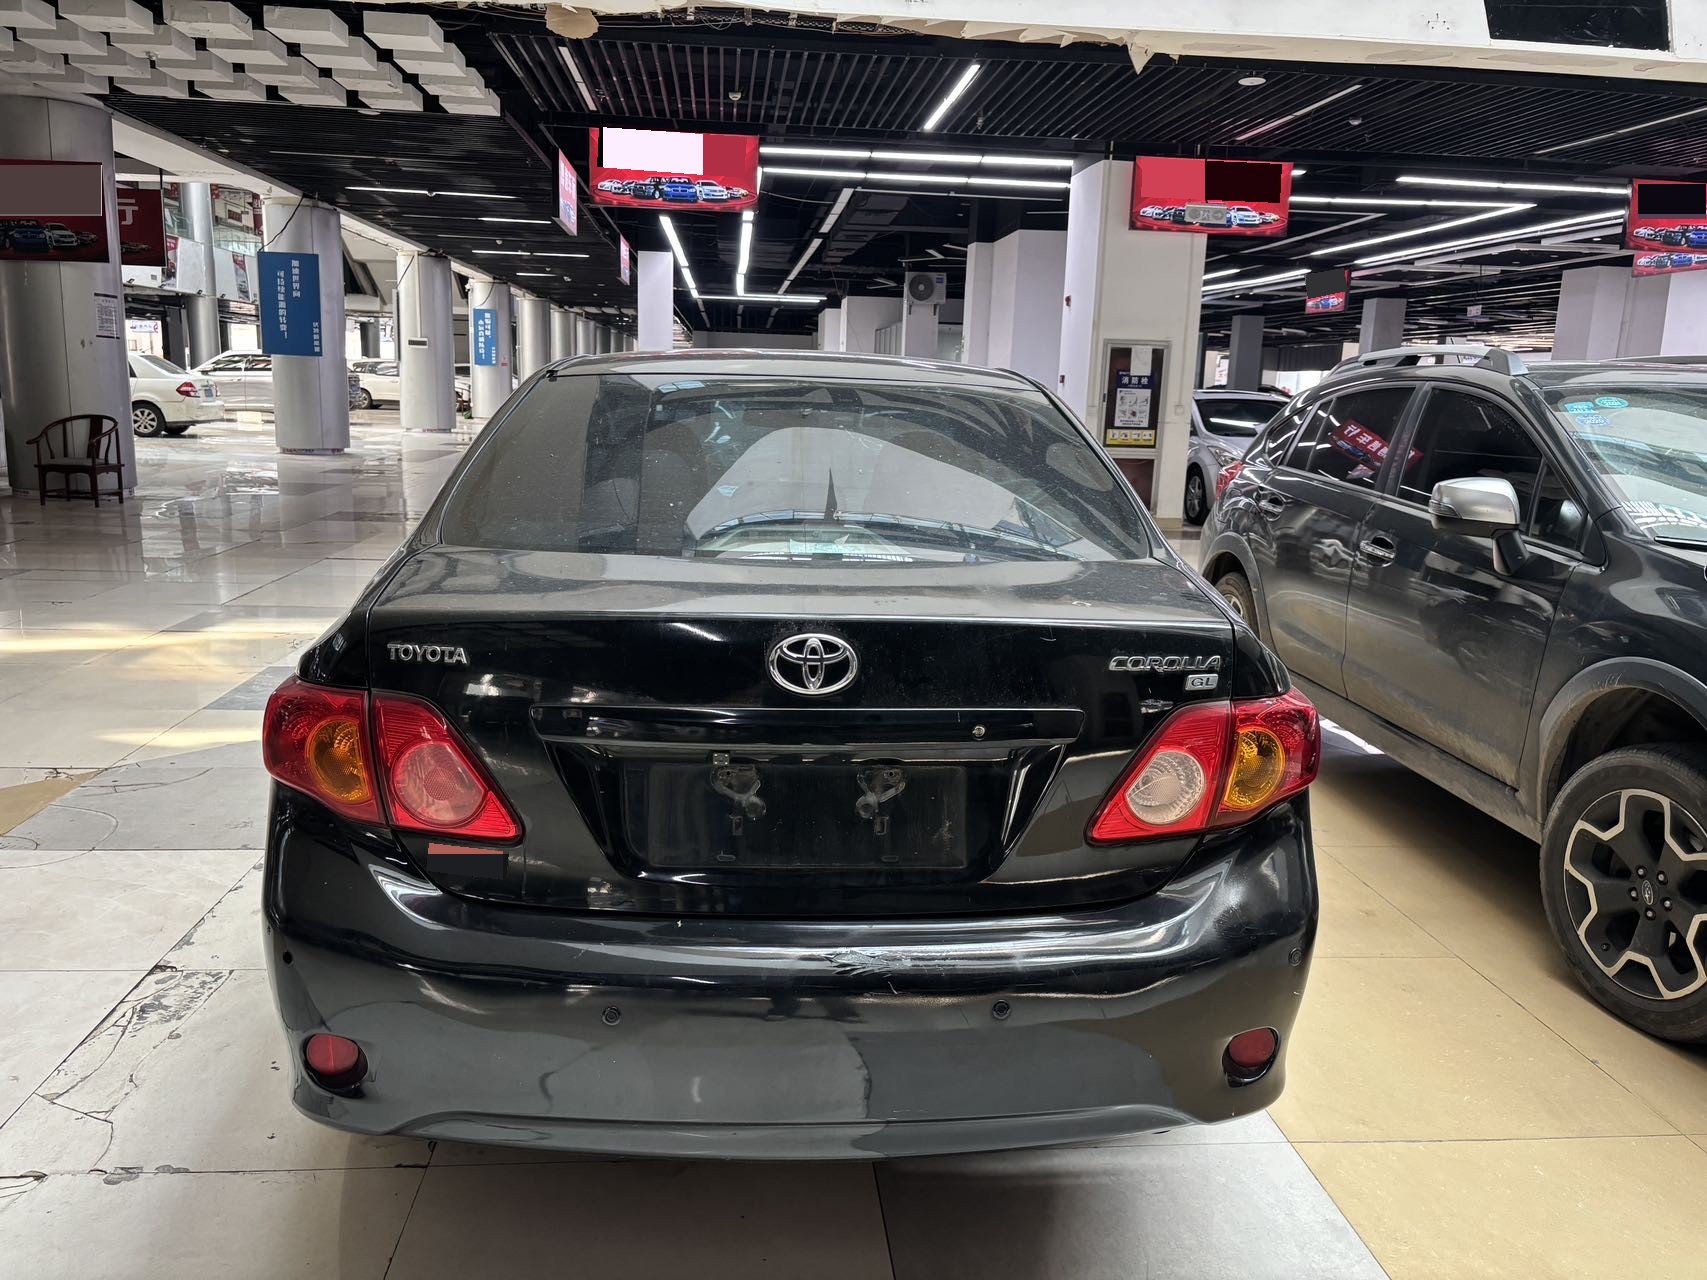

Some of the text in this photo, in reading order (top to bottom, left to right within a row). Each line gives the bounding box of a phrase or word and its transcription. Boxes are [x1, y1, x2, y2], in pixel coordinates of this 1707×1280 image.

[1121, 376, 1149, 385] 消防栓
[387, 643, 467, 664] TOYOTA
[1109, 655, 1221, 672] COROLLA
[1191, 677, 1214, 688] GL
